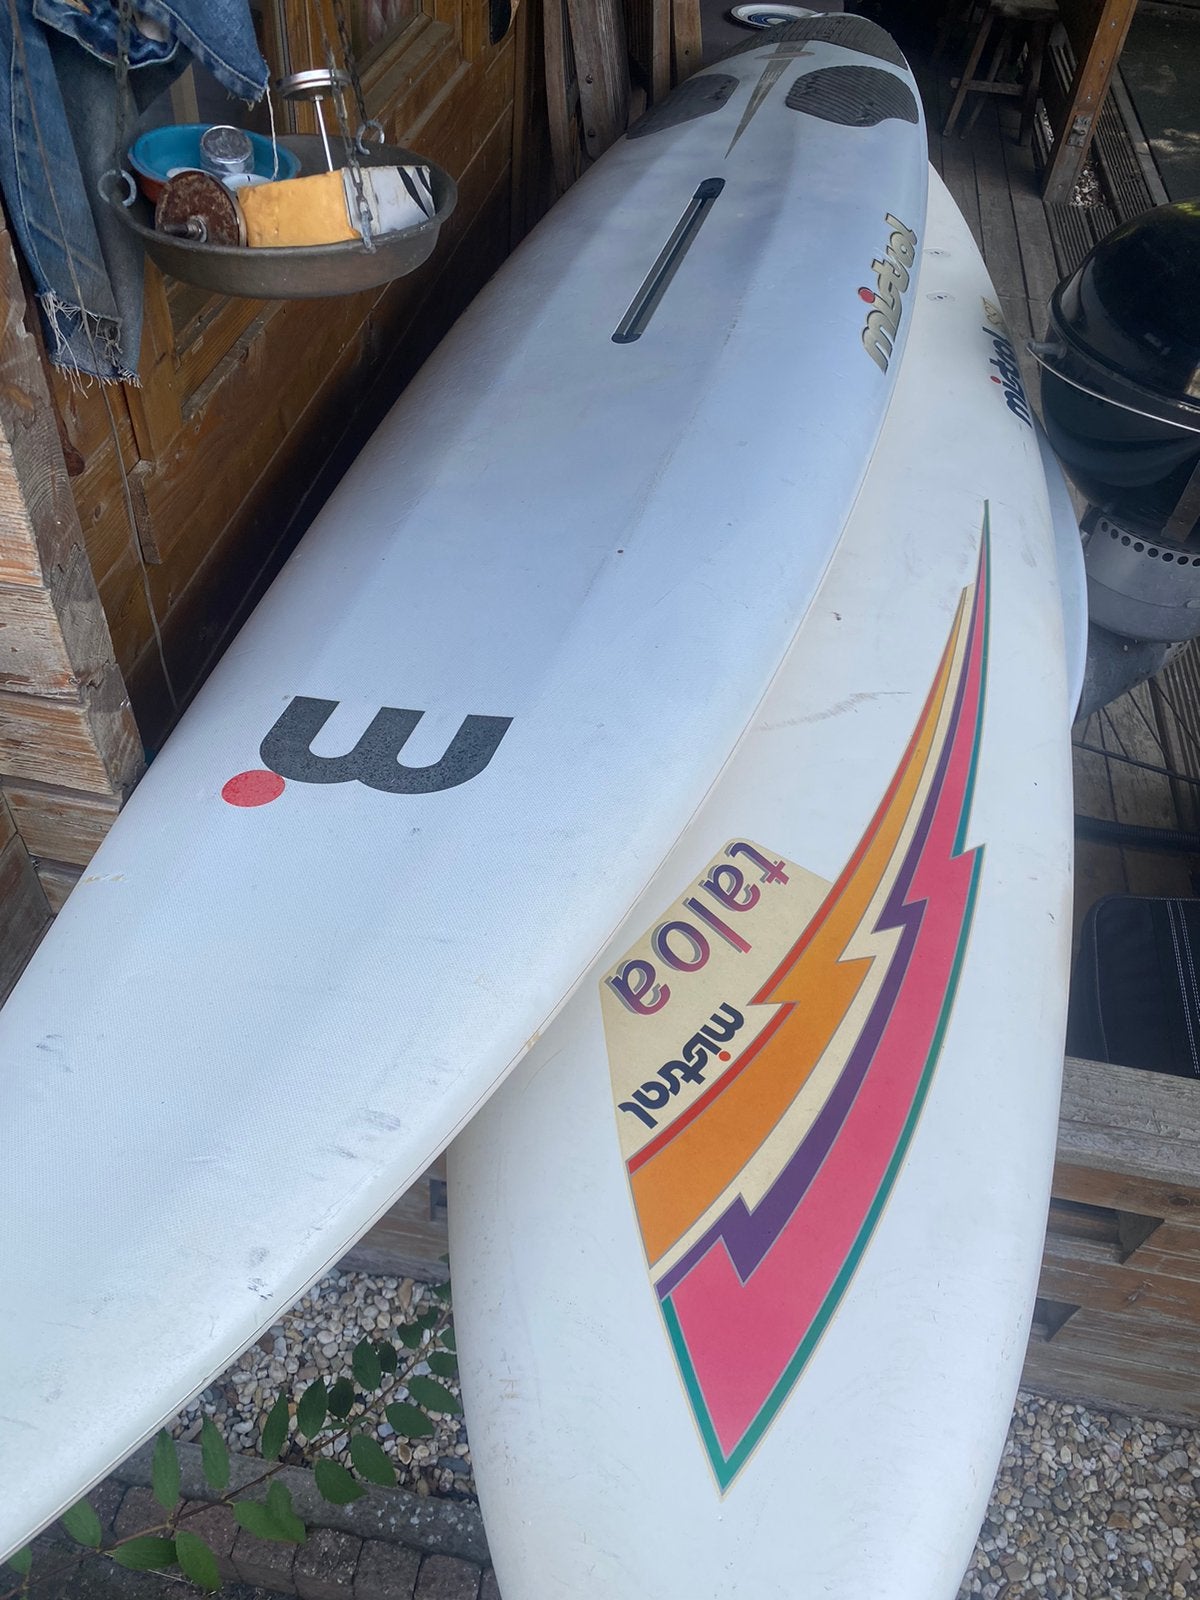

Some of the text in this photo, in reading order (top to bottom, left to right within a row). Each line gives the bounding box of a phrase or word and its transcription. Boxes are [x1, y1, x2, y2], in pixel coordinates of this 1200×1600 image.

[858, 213, 917, 376] mistral
[982, 327, 1033, 429] mistral
[604, 841, 790, 1015] taloa
[618, 1001, 745, 1130] mistral
